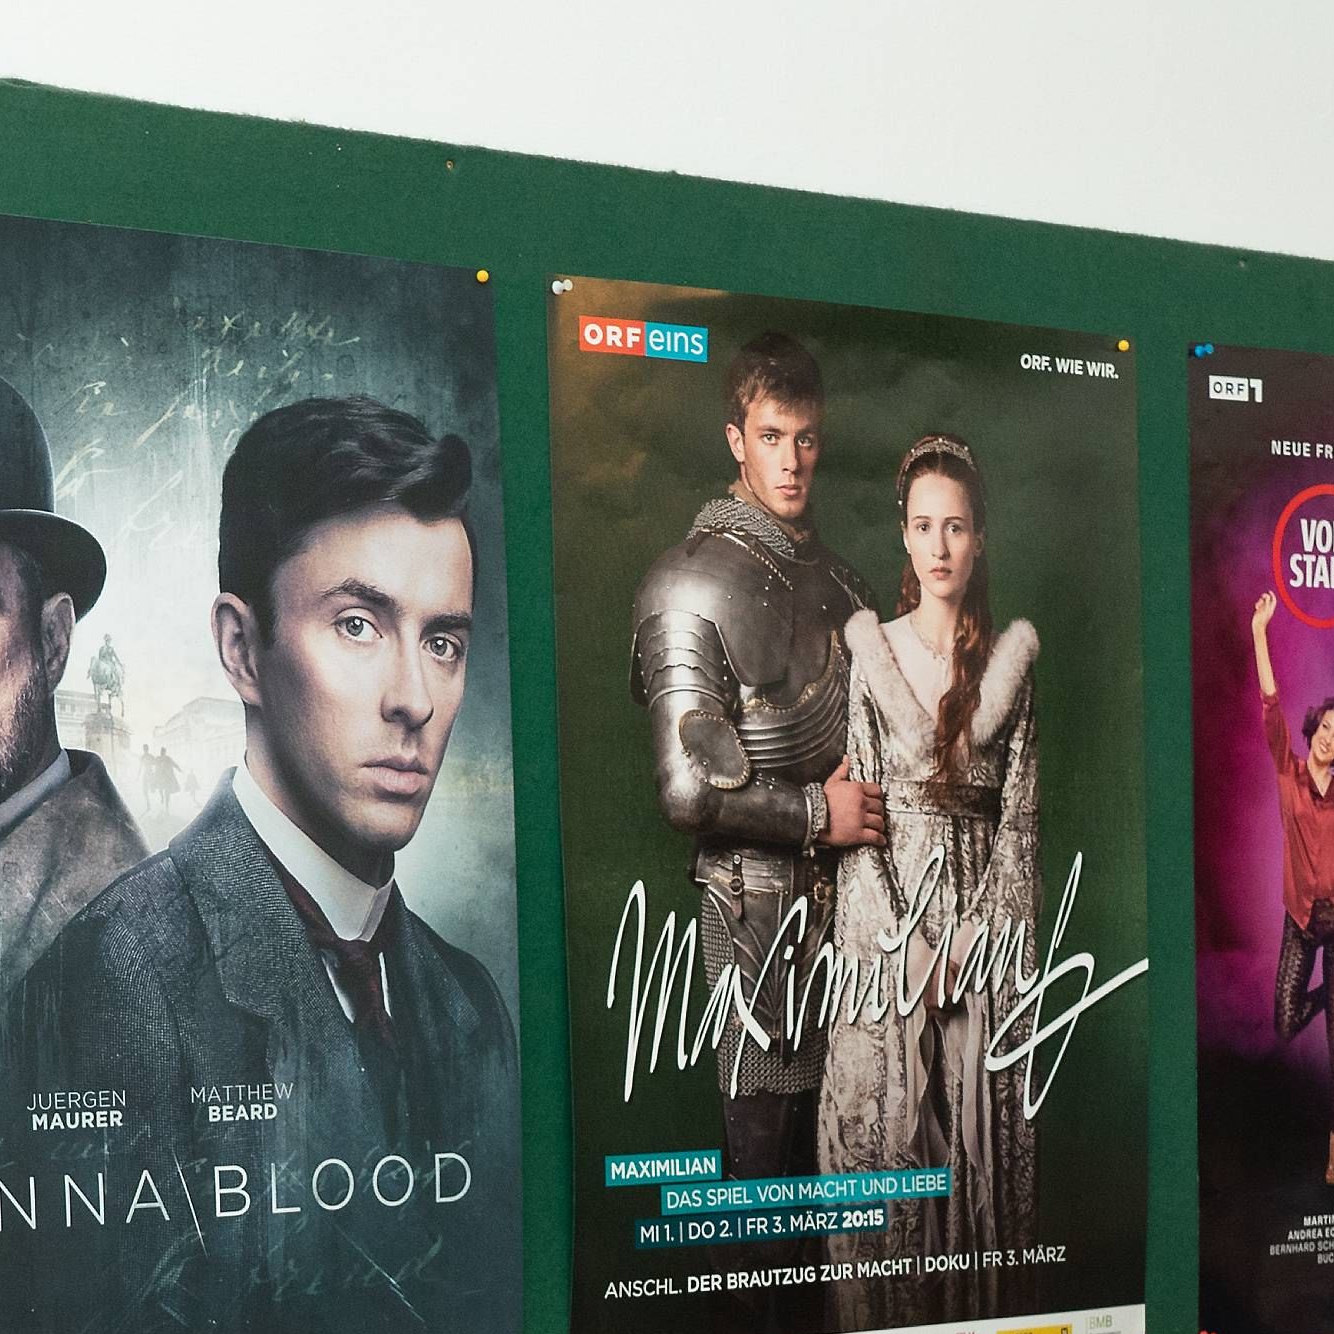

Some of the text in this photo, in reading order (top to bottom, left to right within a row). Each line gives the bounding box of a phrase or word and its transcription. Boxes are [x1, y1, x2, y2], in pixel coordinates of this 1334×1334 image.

[584, 323, 642, 349] ORF
[1020, 354, 1119, 379] ORF. WIE WIR.
[1213, 378, 1263, 403] ORF 1
[1271, 440, 1311, 458] NEUE
[27, 1090, 126, 1111] JUERGEN
[191, 1082, 294, 1103] MATTHEW
[32, 1111, 123, 1131] MAURER
[208, 1103, 278, 1123] BEARD
[610, 1156, 716, 1180] MAXIMILIAN
[213, 1152, 473, 1219] BLOOD
[666, 1173, 947, 1209] DAS SPIEL VON MACHT UND LIEBE
[640, 1225, 660, 1243] MI
[688, 1221, 715, 1240] DO
[719, 1219, 733, 1238] 2.
[746, 1217, 768, 1235] FR
[772, 1215, 786, 1234] 3.
[790, 1210, 838, 1232] MÄRZ
[842, 1208, 884, 1227] 20:15
[1287, 1227, 1323, 1241] ANDREA
[1270, 1241, 1316, 1256] BERNHARD
[604, 1244, 1066, 1300] ANSCHL. DER BRAUTZUG ZUR MACHT DOKU FR 3. MÄRZ
